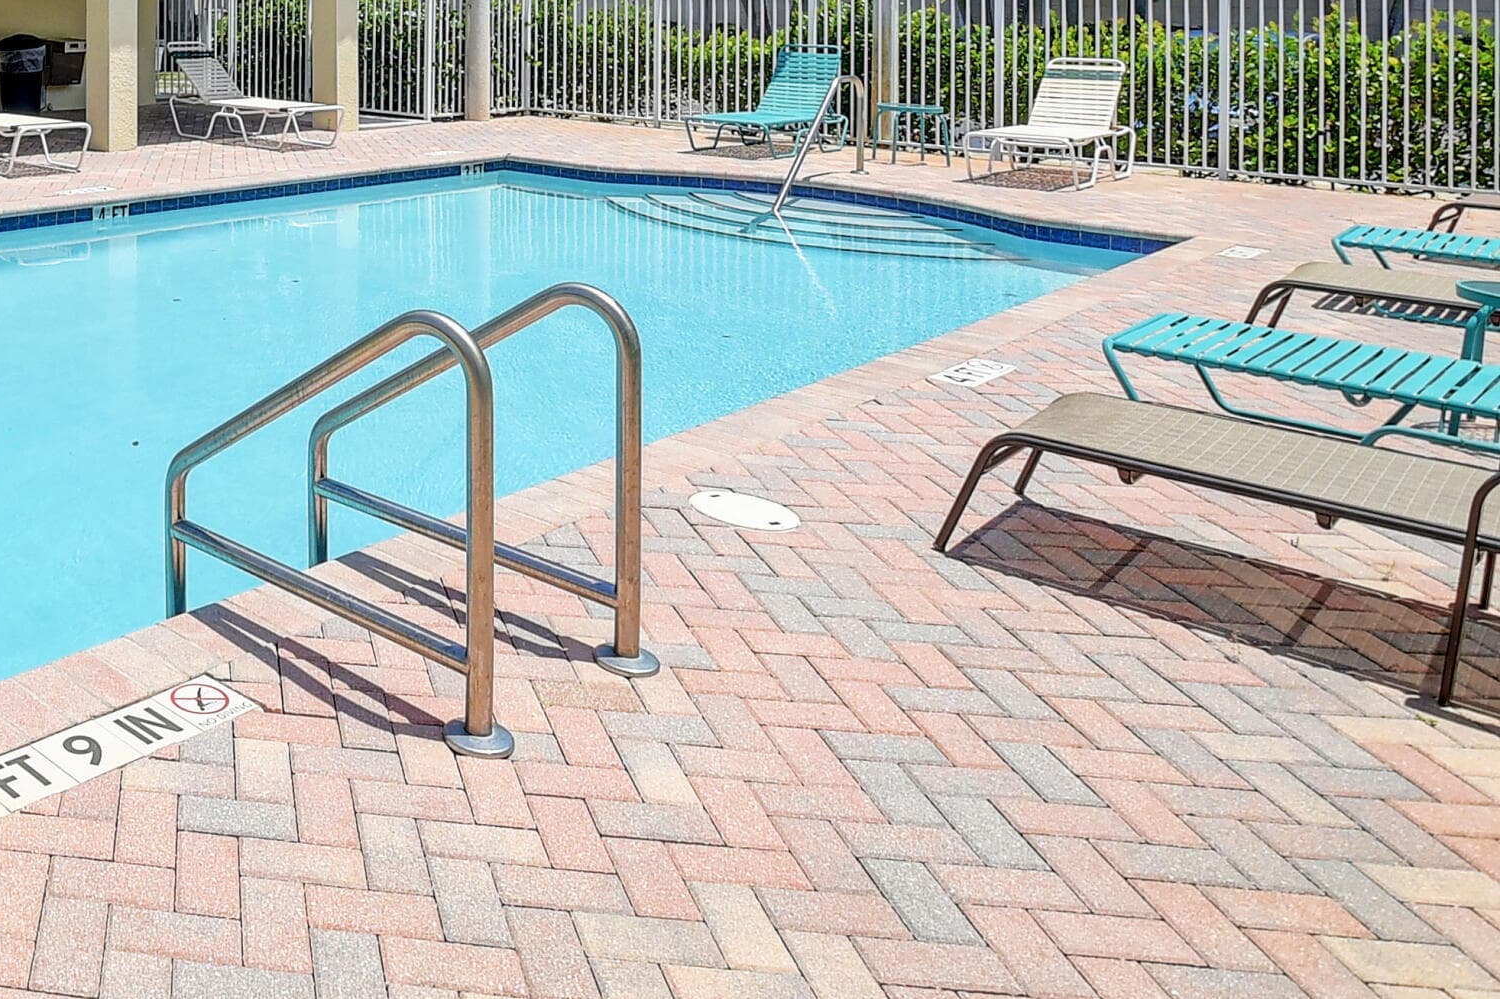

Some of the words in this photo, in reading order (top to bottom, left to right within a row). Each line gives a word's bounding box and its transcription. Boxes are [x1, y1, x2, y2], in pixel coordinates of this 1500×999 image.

[112, 205, 128, 217] FT
[198, 718, 217, 728] NO
[216, 702, 253, 720] DIVING
[62, 735, 102, 766] 9
[112, 707, 184, 745] IN
